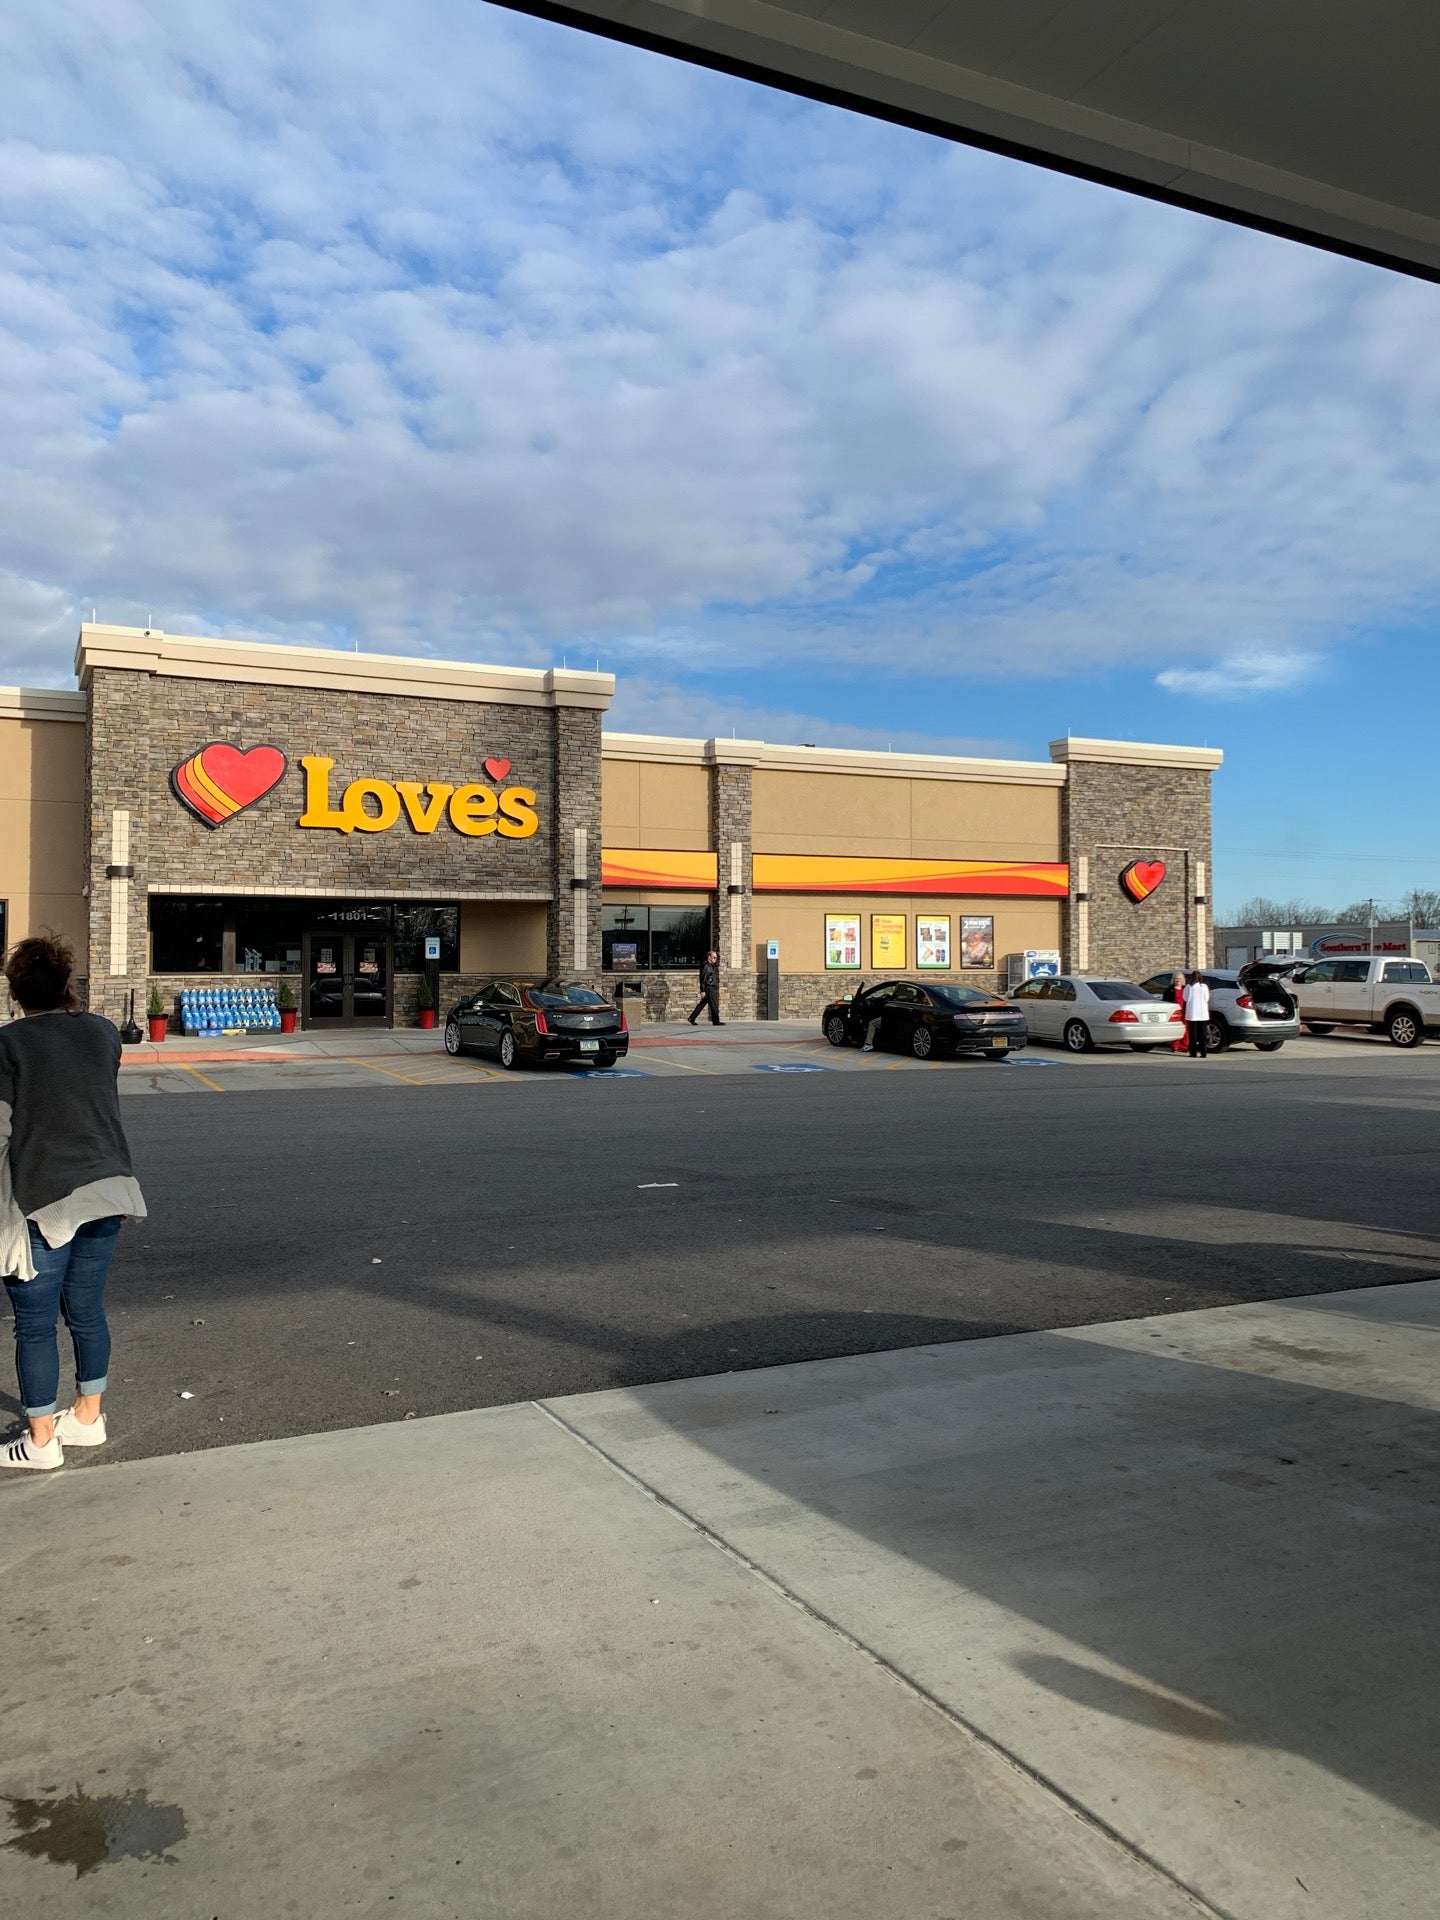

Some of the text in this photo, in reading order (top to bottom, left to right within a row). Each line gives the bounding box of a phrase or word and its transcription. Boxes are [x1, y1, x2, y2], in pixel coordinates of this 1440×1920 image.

[333, 912, 367, 920] 11801
[1320, 942, 1407, 952] Southern Tre Mart
